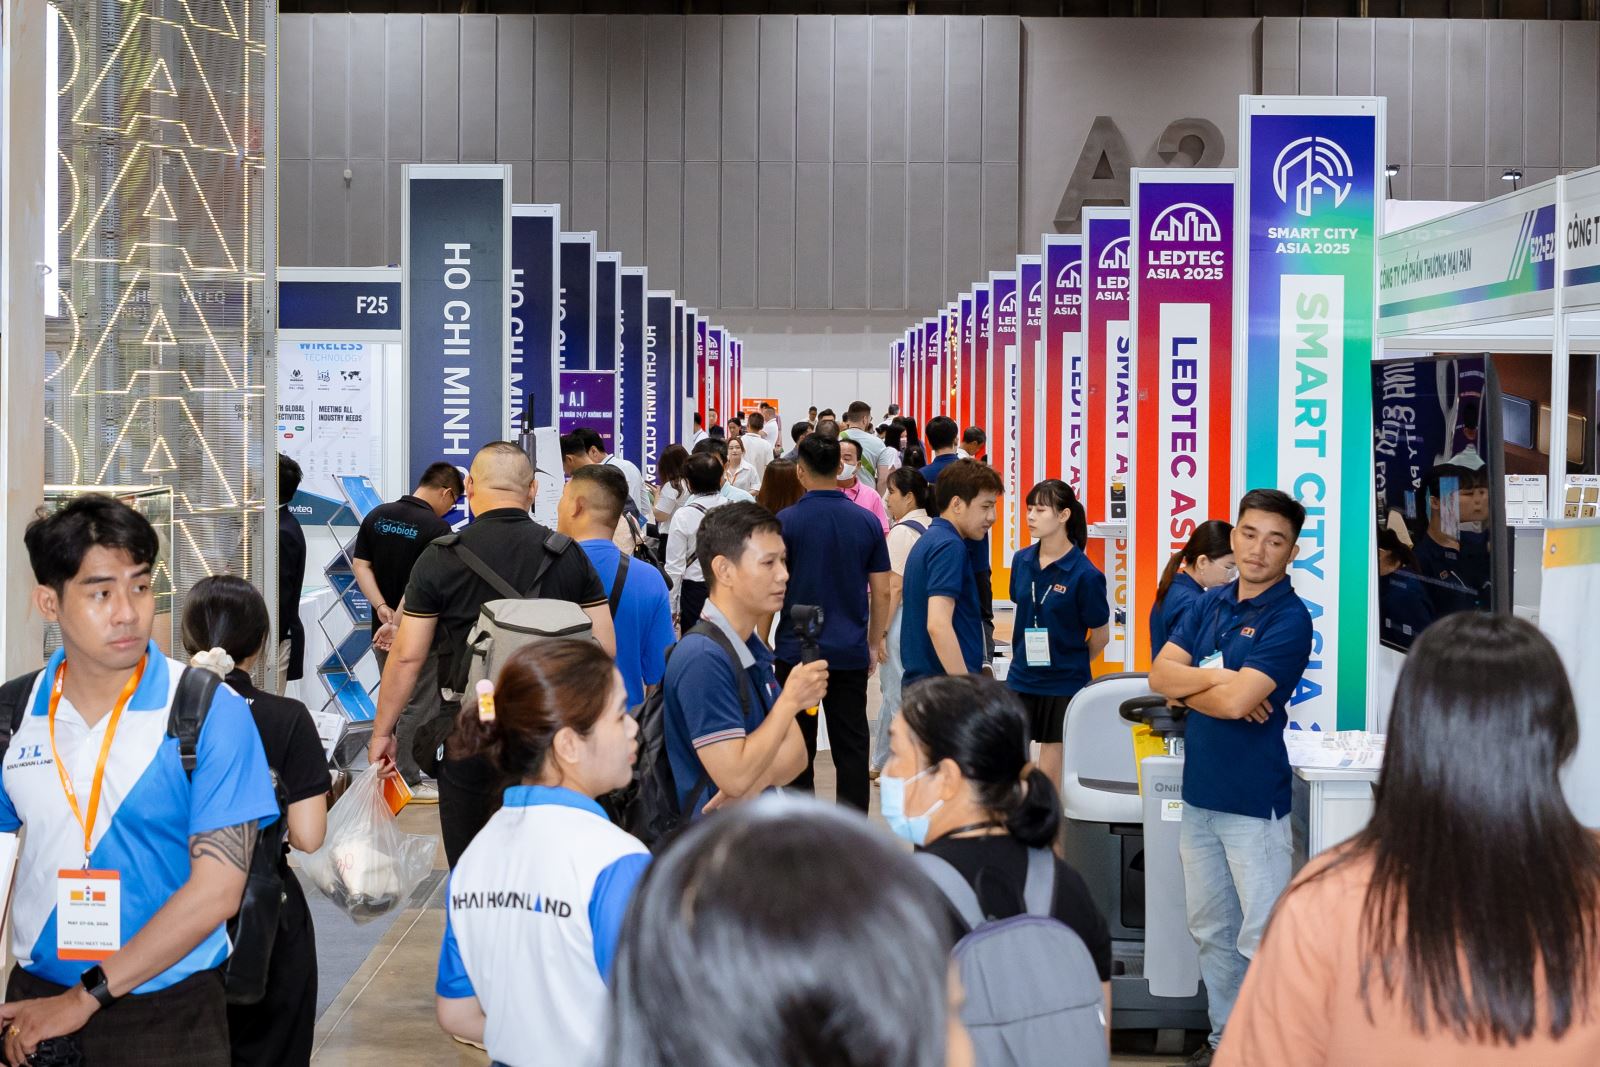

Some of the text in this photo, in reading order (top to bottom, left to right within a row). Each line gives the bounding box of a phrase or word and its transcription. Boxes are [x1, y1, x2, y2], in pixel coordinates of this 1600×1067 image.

[1268, 227, 1358, 240] SMART CITY
[1567, 212, 1600, 250] CÔNG T
[1275, 242, 1350, 254] ASIA 2025
[1148, 250, 1225, 266] LEDTEC
[1460, 247, 1472, 272] PAN
[444, 243, 471, 290] HO
[1147, 267, 1224, 280] ASIA 2025
[1097, 276, 1130, 289] LED
[1055, 294, 1082, 305] LED
[1096, 291, 1124, 301] ASIA
[356, 296, 388, 314] F25
[1054, 307, 1078, 315] ASIA
[998, 316, 1016, 325] LED
[1026, 318, 1041, 326] ASI
[443, 300, 471, 355] CHI
[304, 353, 362, 362] TECHNOLOGY
[1293, 292, 1329, 458] SMART
[511, 373, 524, 428] MIN
[285, 404, 305, 412] GLOBAL
[318, 405, 342, 413] MEETING
[443, 367, 471, 455] MINH
[318, 414, 343, 422] INDUSTRY
[1169, 337, 1198, 562] LEDTEC ASI
[647, 464, 657, 487] PA
[1291, 472, 1328, 580] CITY
